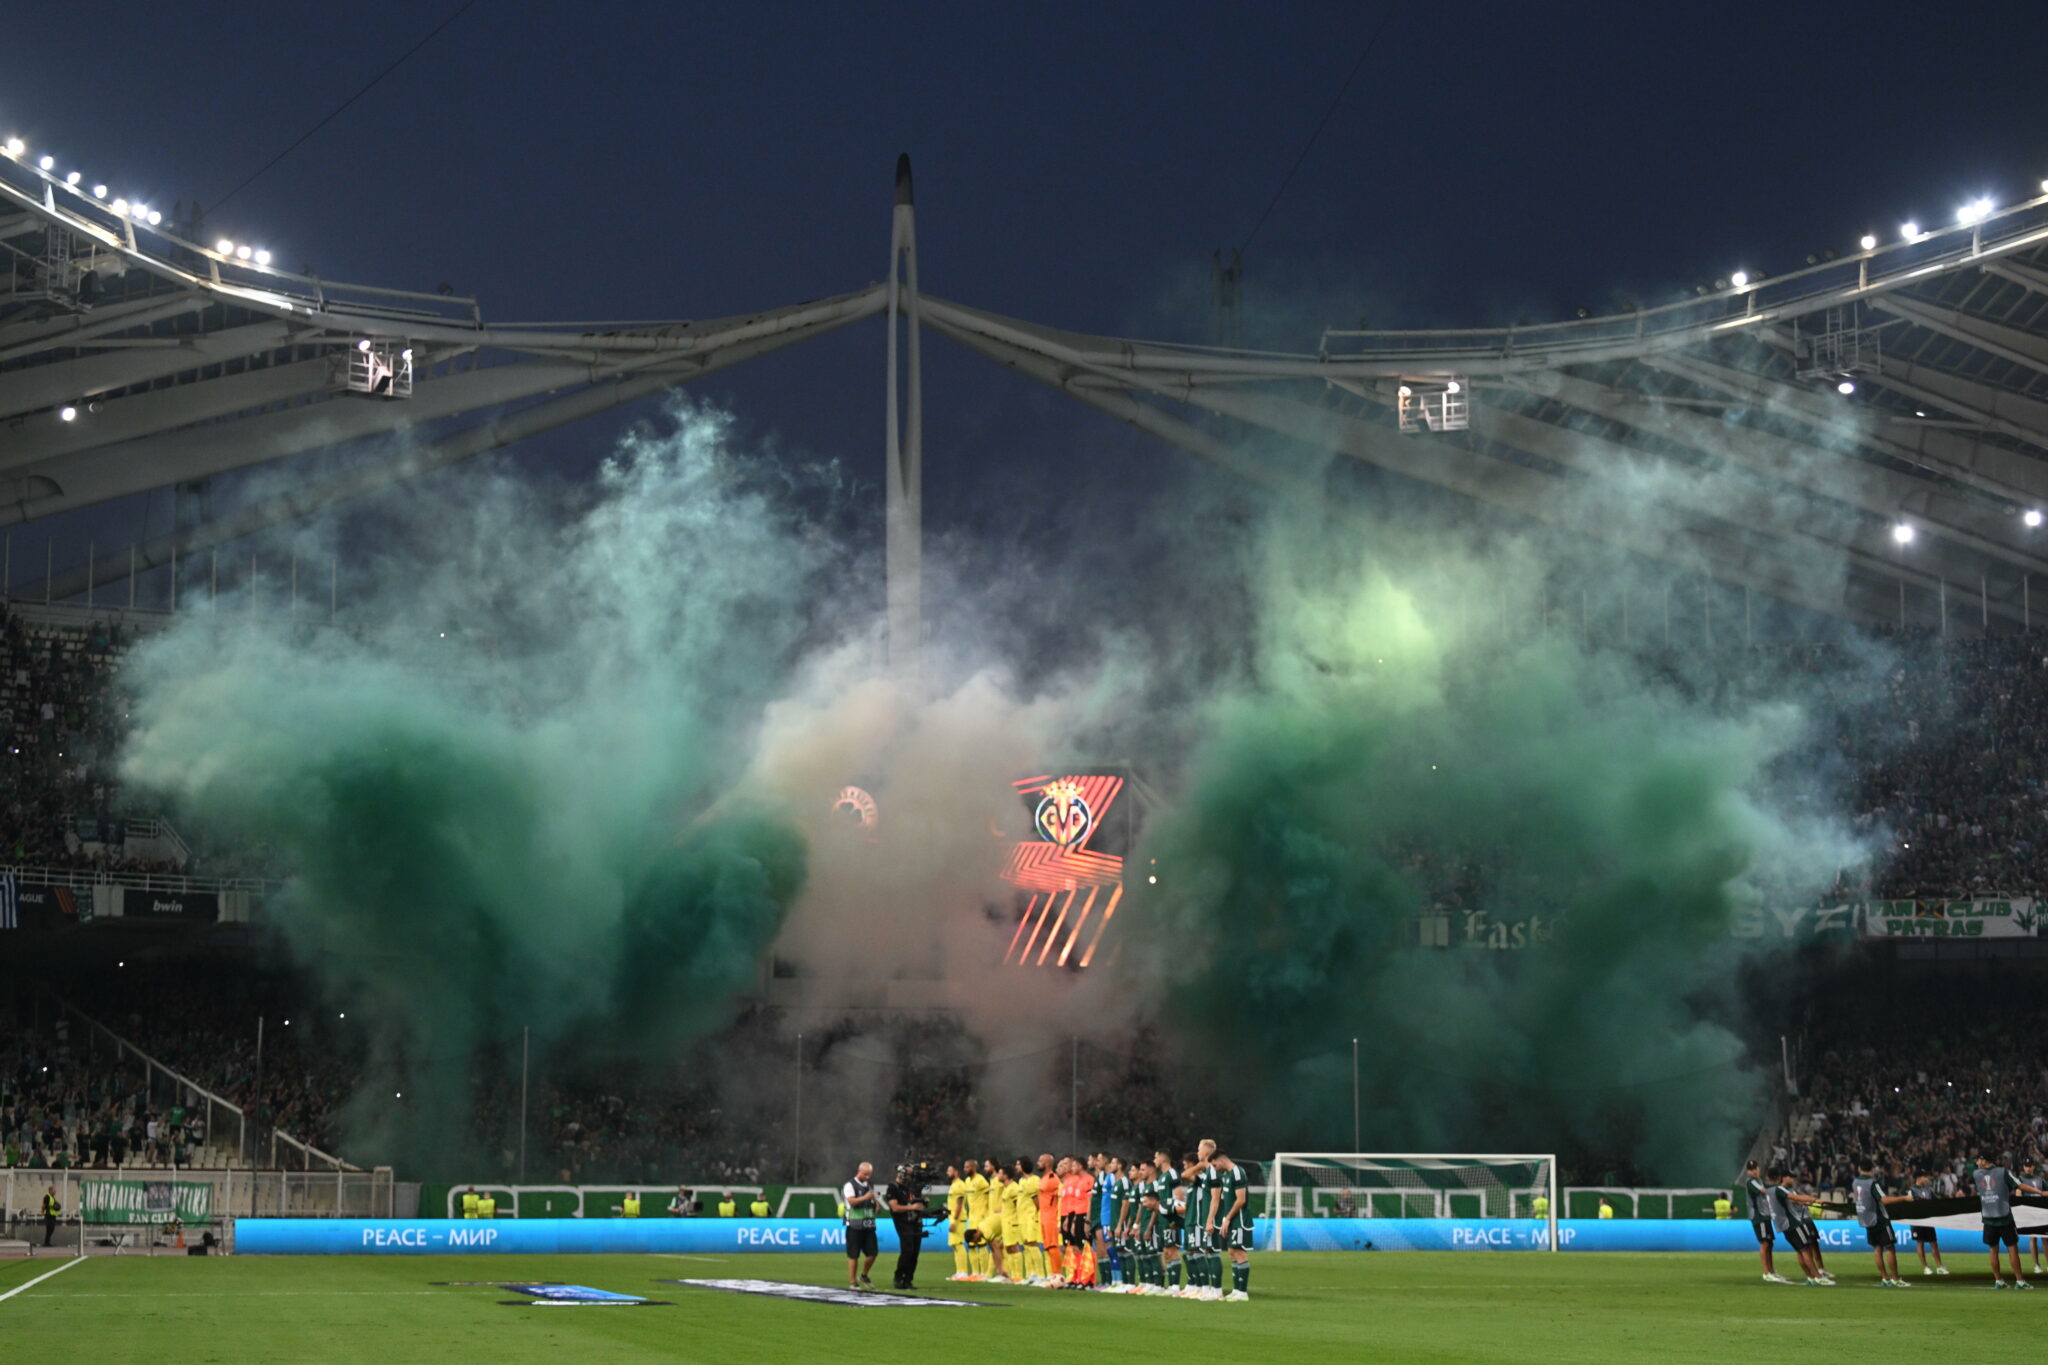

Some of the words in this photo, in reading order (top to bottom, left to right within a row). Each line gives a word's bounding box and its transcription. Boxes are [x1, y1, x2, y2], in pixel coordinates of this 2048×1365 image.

[19, 893, 44, 904] AGUE
[153, 899, 183, 912] bwin
[1869, 902, 1913, 917] FAN
[1947, 901, 2012, 917] CLUB
[1887, 919, 1983, 936] PATRAS
[128, 1213, 149, 1223] FAN
[363, 1229, 427, 1246] PEACE
[449, 1229, 498, 1246] МИР
[737, 1228, 800, 1245] PEACE
[1453, 1228, 1512, 1245] PEACE
[1818, 1229, 1852, 1245] ACE
